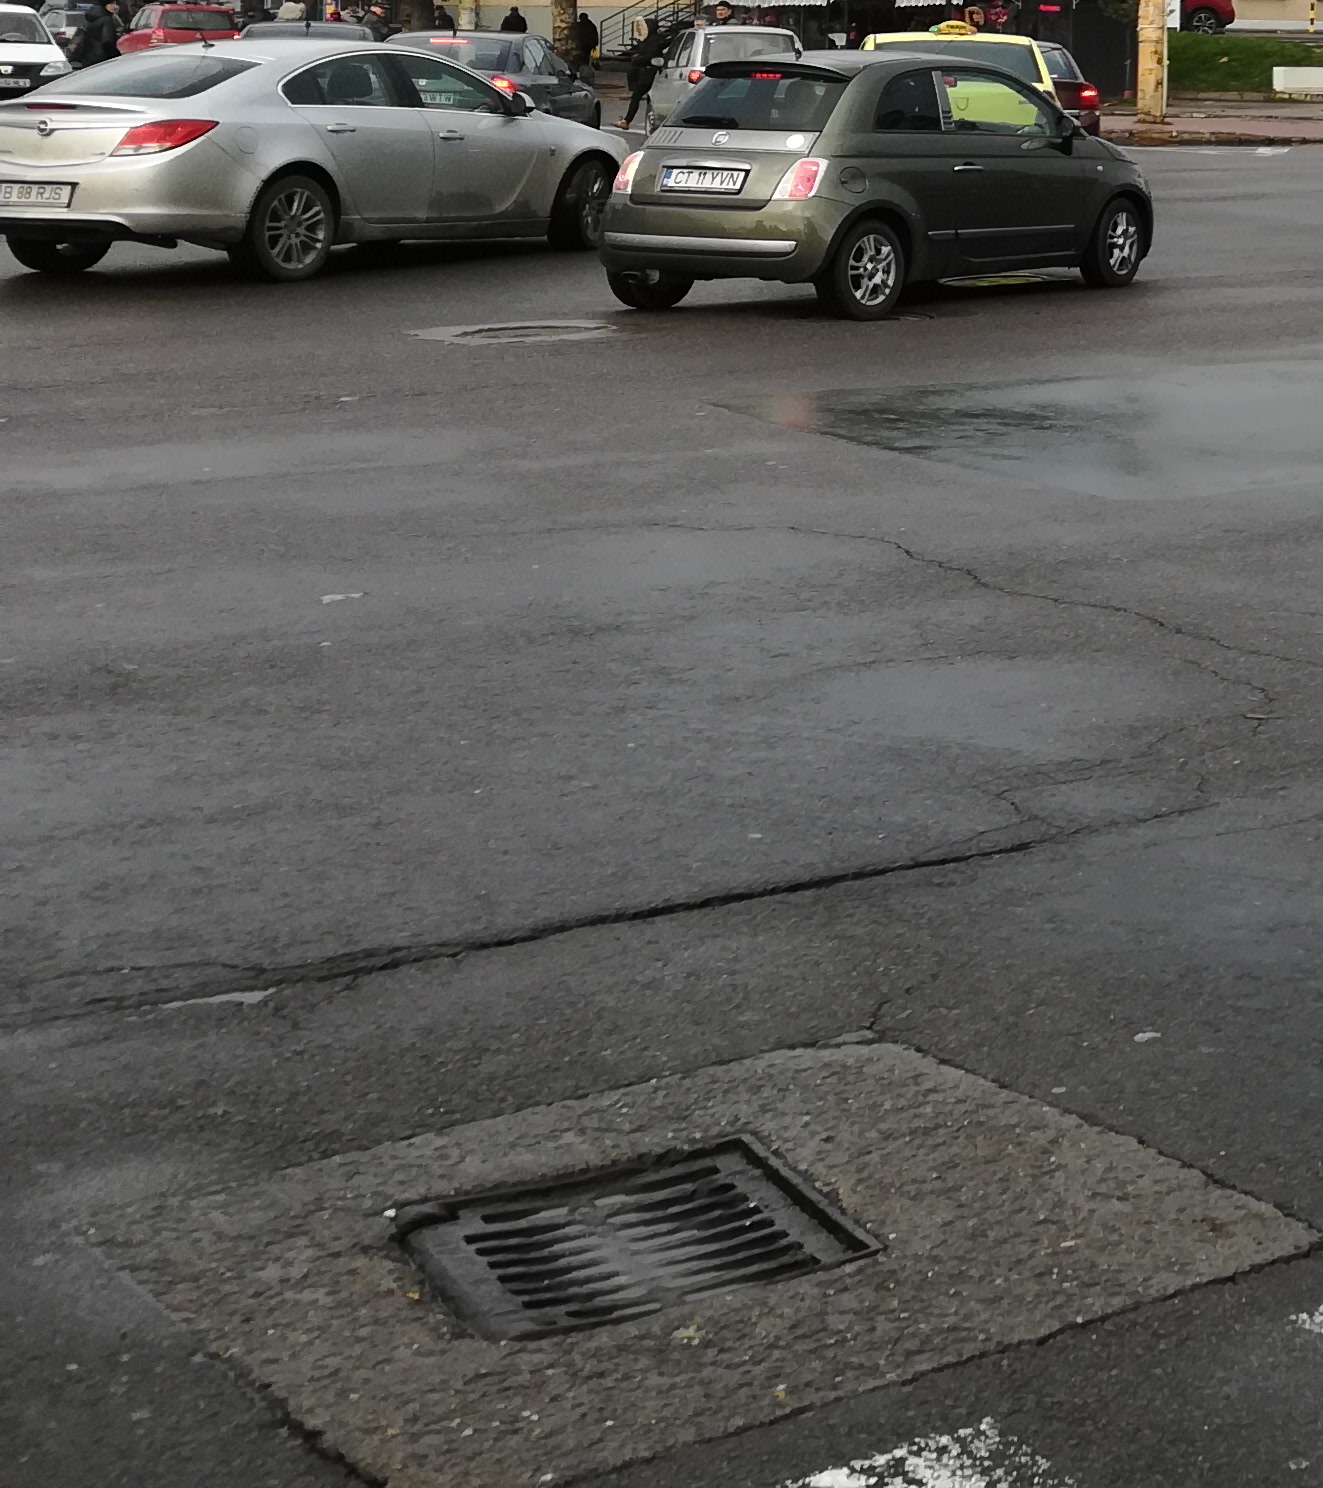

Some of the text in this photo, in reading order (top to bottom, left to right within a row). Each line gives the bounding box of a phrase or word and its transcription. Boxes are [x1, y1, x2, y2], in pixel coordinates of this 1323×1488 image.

[673, 170, 740, 187] CT 11 YVN
[2, 185, 13, 200] B
[35, 185, 63, 201] RJS
